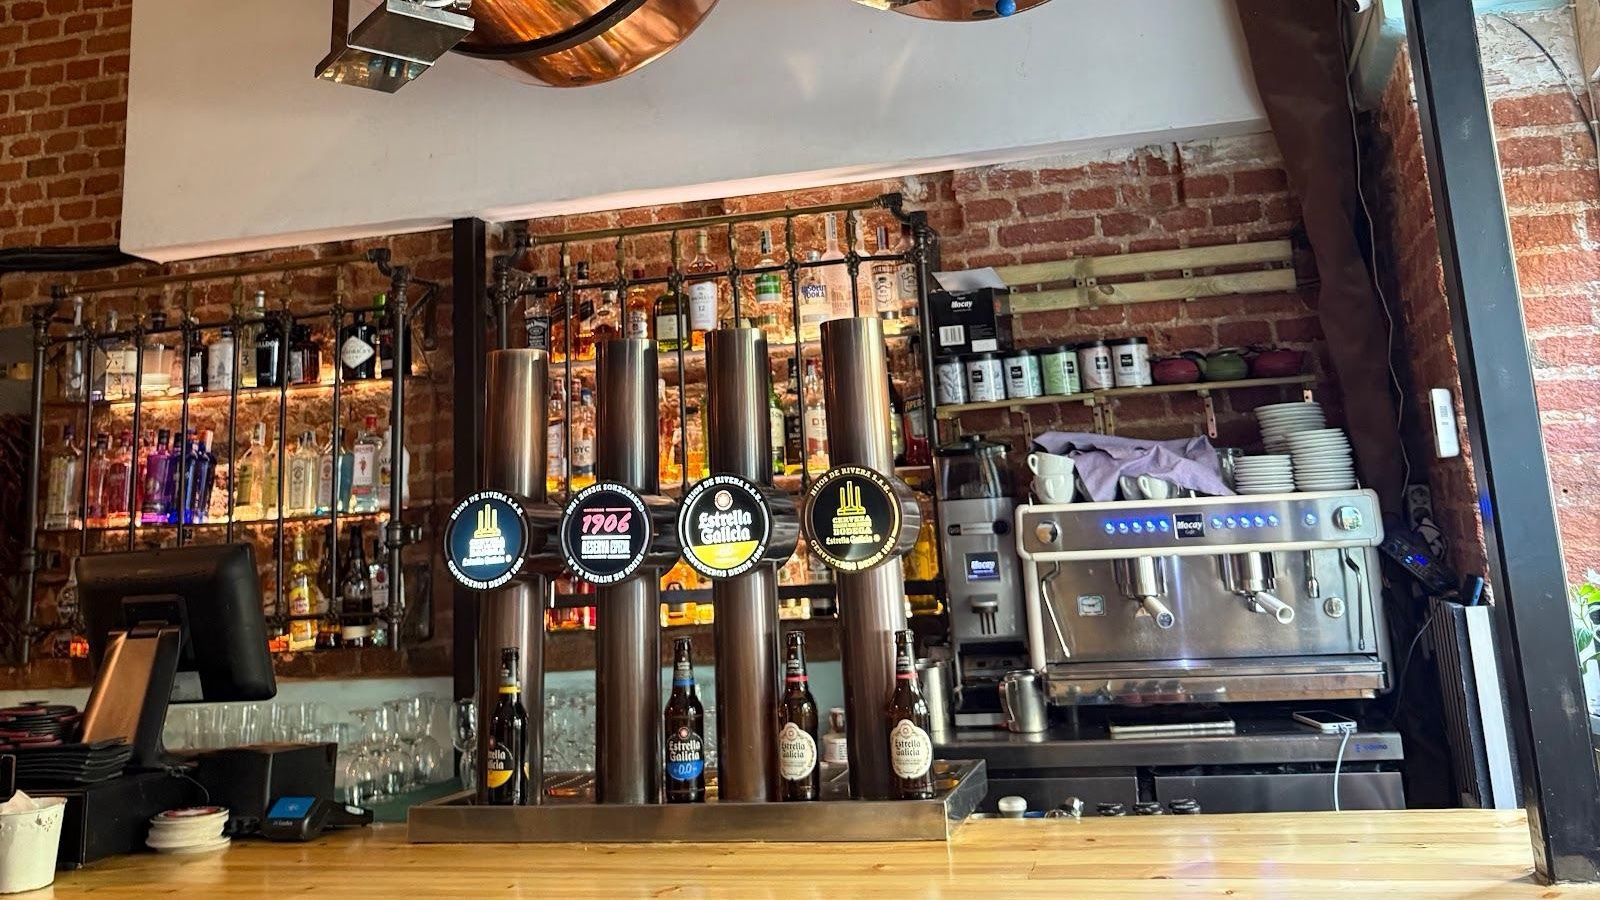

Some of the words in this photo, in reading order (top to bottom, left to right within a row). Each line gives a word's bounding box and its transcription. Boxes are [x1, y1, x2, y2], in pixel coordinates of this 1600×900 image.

[812, 417, 827, 426] DY
[574, 446, 590, 454] DYC
[703, 478, 714, 489] DE
[715, 476, 744, 488] RIVERA
[810, 477, 829, 497] HIJOS
[828, 469, 840, 479] DE
[841, 467, 871, 478] RIVERA
[480, 491, 508, 502] RIVERA
[582, 512, 632, 535] 1906
[698, 509, 753, 529] Estrella
[1176, 521, 1203, 530] Mocay
[700, 525, 751, 545] Galicia
[669, 740, 701, 751] Estrella
[670, 751, 700, 762] Galicia
